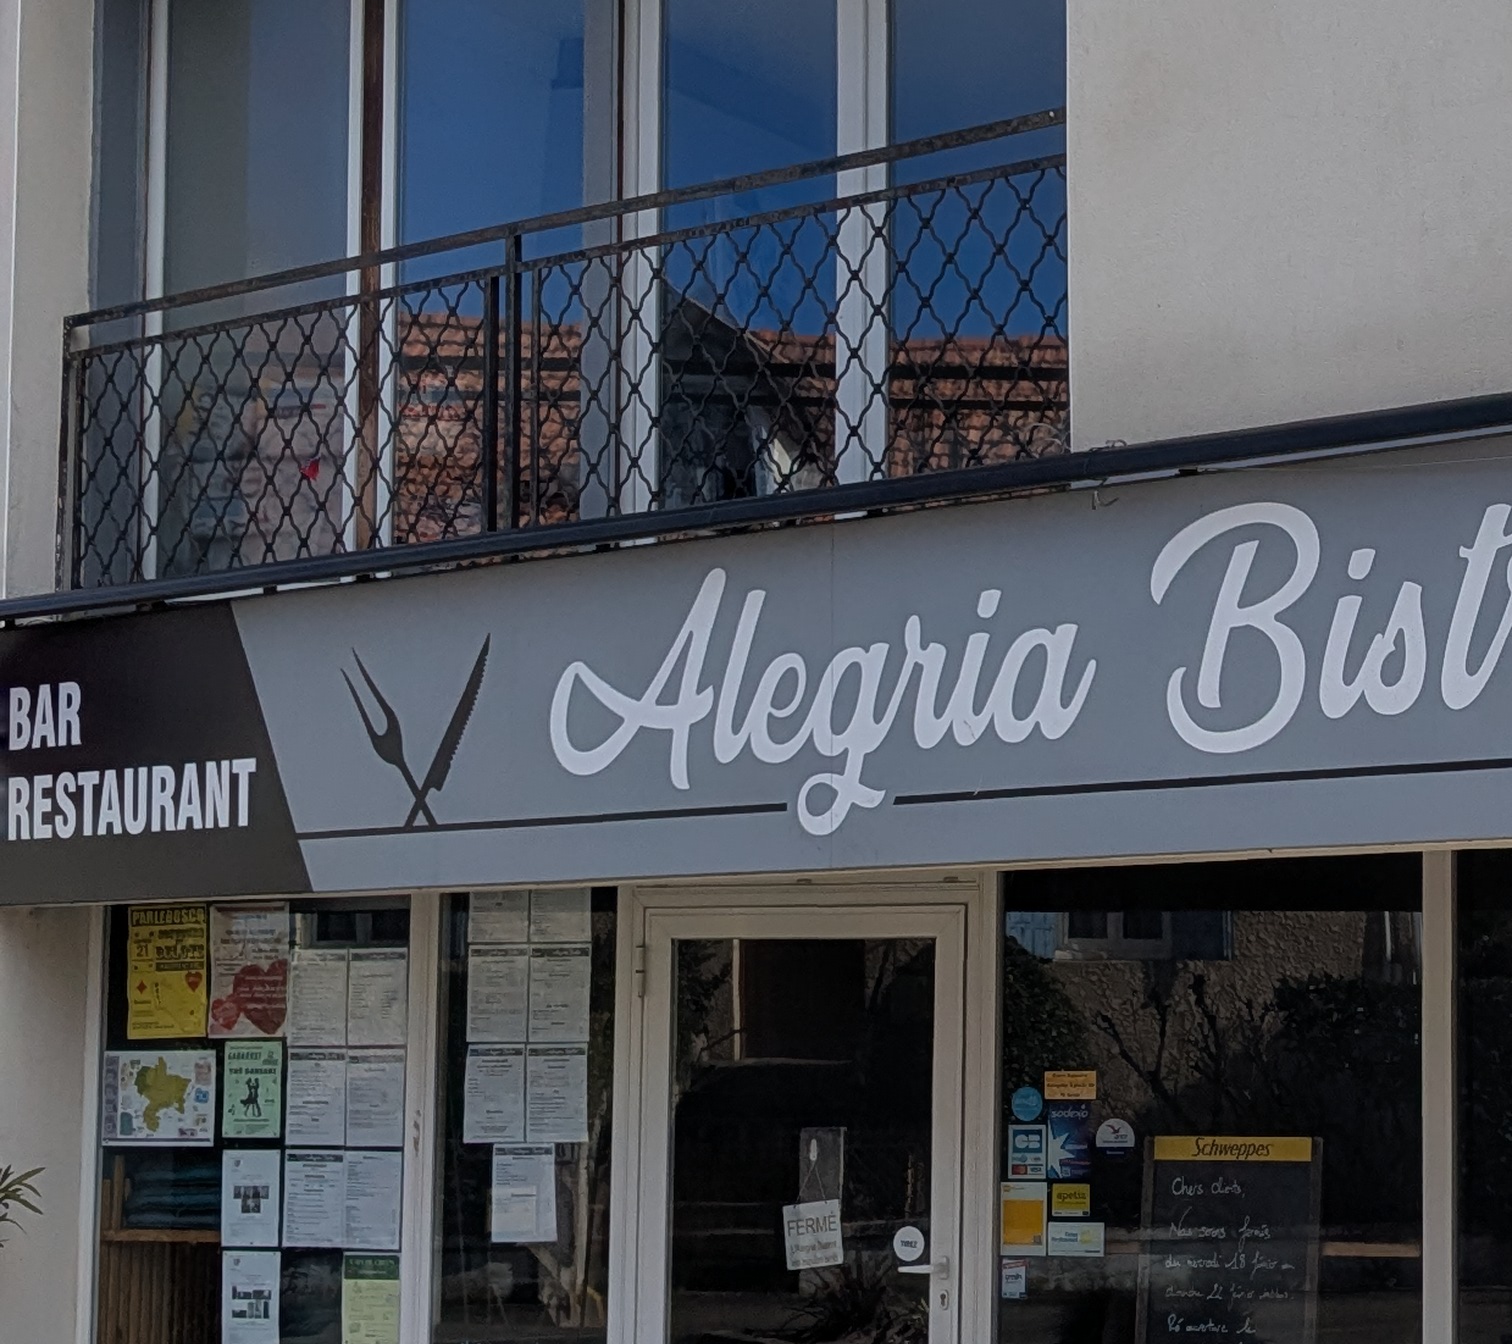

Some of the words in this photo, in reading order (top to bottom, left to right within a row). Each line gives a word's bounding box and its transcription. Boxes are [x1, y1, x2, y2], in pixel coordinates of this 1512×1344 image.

[550, 568, 1097, 835] Alegria
[9, 681, 82, 751] BAR
[8, 757, 257, 840] RESTAURANT
[136, 944, 149, 957] 21
[1051, 1103, 1089, 1120] sodexo
[1192, 1137, 1274, 1160] Schweppes
[787, 1210, 838, 1237] FERMÉ
[900, 1240, 917, 1248] TIREZ
